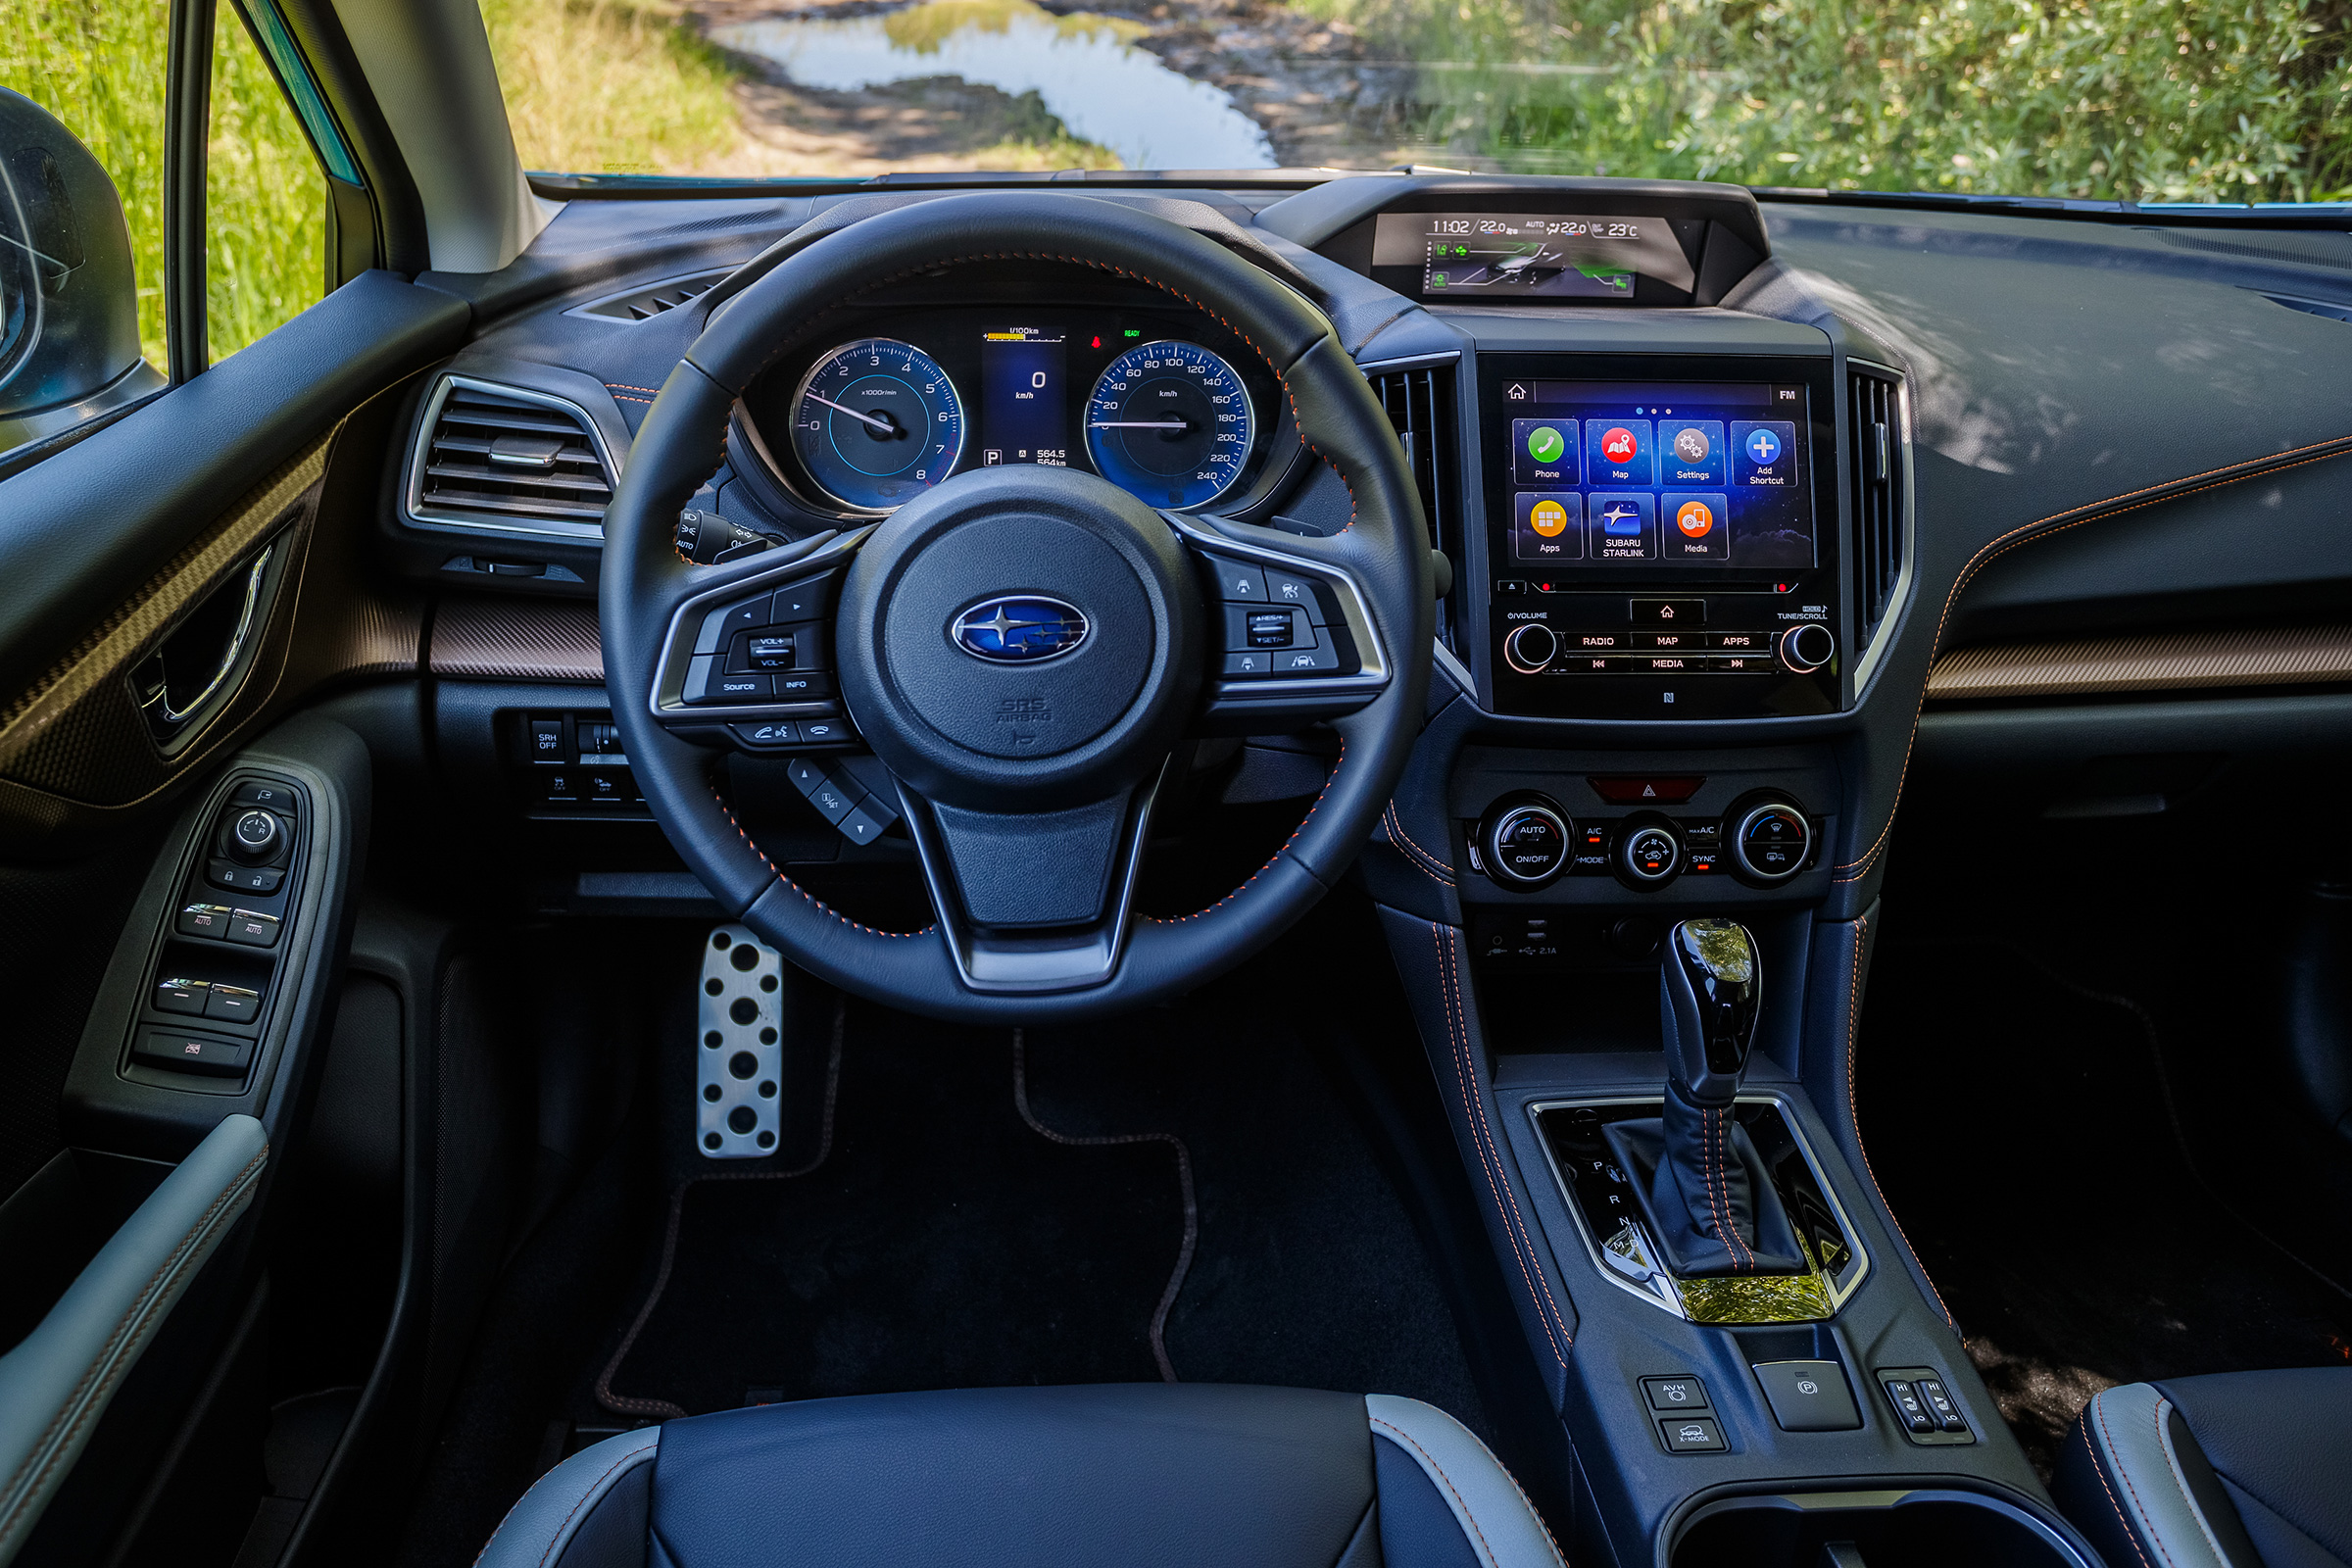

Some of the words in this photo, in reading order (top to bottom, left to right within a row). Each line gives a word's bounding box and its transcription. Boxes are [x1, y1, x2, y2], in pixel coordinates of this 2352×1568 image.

[1433, 220, 1470, 233] 11:02
[1480, 220, 1506, 232] 22.0
[1560, 221, 1587, 234] 22.0
[870, 356, 880, 367] 3
[839, 367, 849, 376] 2
[902, 363, 911, 372] 4
[1187, 365, 1205, 374] 120
[1126, 368, 1142, 377] 60
[1031, 371, 1047, 388] 0
[1202, 377, 1223, 386] 140
[925, 383, 935, 394] 5
[1110, 382, 1127, 391] 40
[1211, 395, 1231, 404] 160
[1780, 390, 1795, 400] FM
[1102, 401, 1118, 410] 20
[937, 412, 949, 422] 6
[1217, 414, 1237, 422] 180
[809, 420, 820, 431] 0
[1217, 433, 1237, 442] 200
[935, 445, 945, 455] 7
[1037, 450, 1066, 459] 564.5
[988, 451, 999, 466] P
[1210, 454, 1231, 463] 220
[915, 470, 926, 480] 8
[1197, 471, 1218, 480] 240
[1612, 470, 1629, 480] Map
[1676, 470, 1710, 481] Settings
[1750, 476, 1785, 485] Shortcut
[676, 539, 694, 550] AUTO
[1605, 539, 1641, 548] SUBARU
[1540, 543, 1560, 554] Apps
[1685, 544, 1708, 553] Media
[1603, 549, 1644, 558] STARLINK
[1582, 637, 1615, 646] RADIO
[1656, 637, 1679, 646] MAP
[1723, 637, 1750, 646] APPS
[1652, 659, 1684, 668] MEDIA
[723, 682, 756, 691] Source
[1002, 698, 1047, 711] SRS
[996, 712, 1054, 723] AIRBAG
[539, 741, 557, 750] OFF
[1519, 825, 1546, 834] AUTO
[1515, 855, 1549, 864] ON/OFF
[194, 917, 212, 926] AUTO
[245, 925, 263, 935] AUTO
[1593, 1161, 1603, 1170] P
[1609, 1195, 1621, 1204] R
[1619, 1216, 1631, 1227] N
[1662, 1384, 1686, 1393] AVH
[1928, 1383, 1940, 1392] HI
[1944, 1413, 1958, 1422] LO
